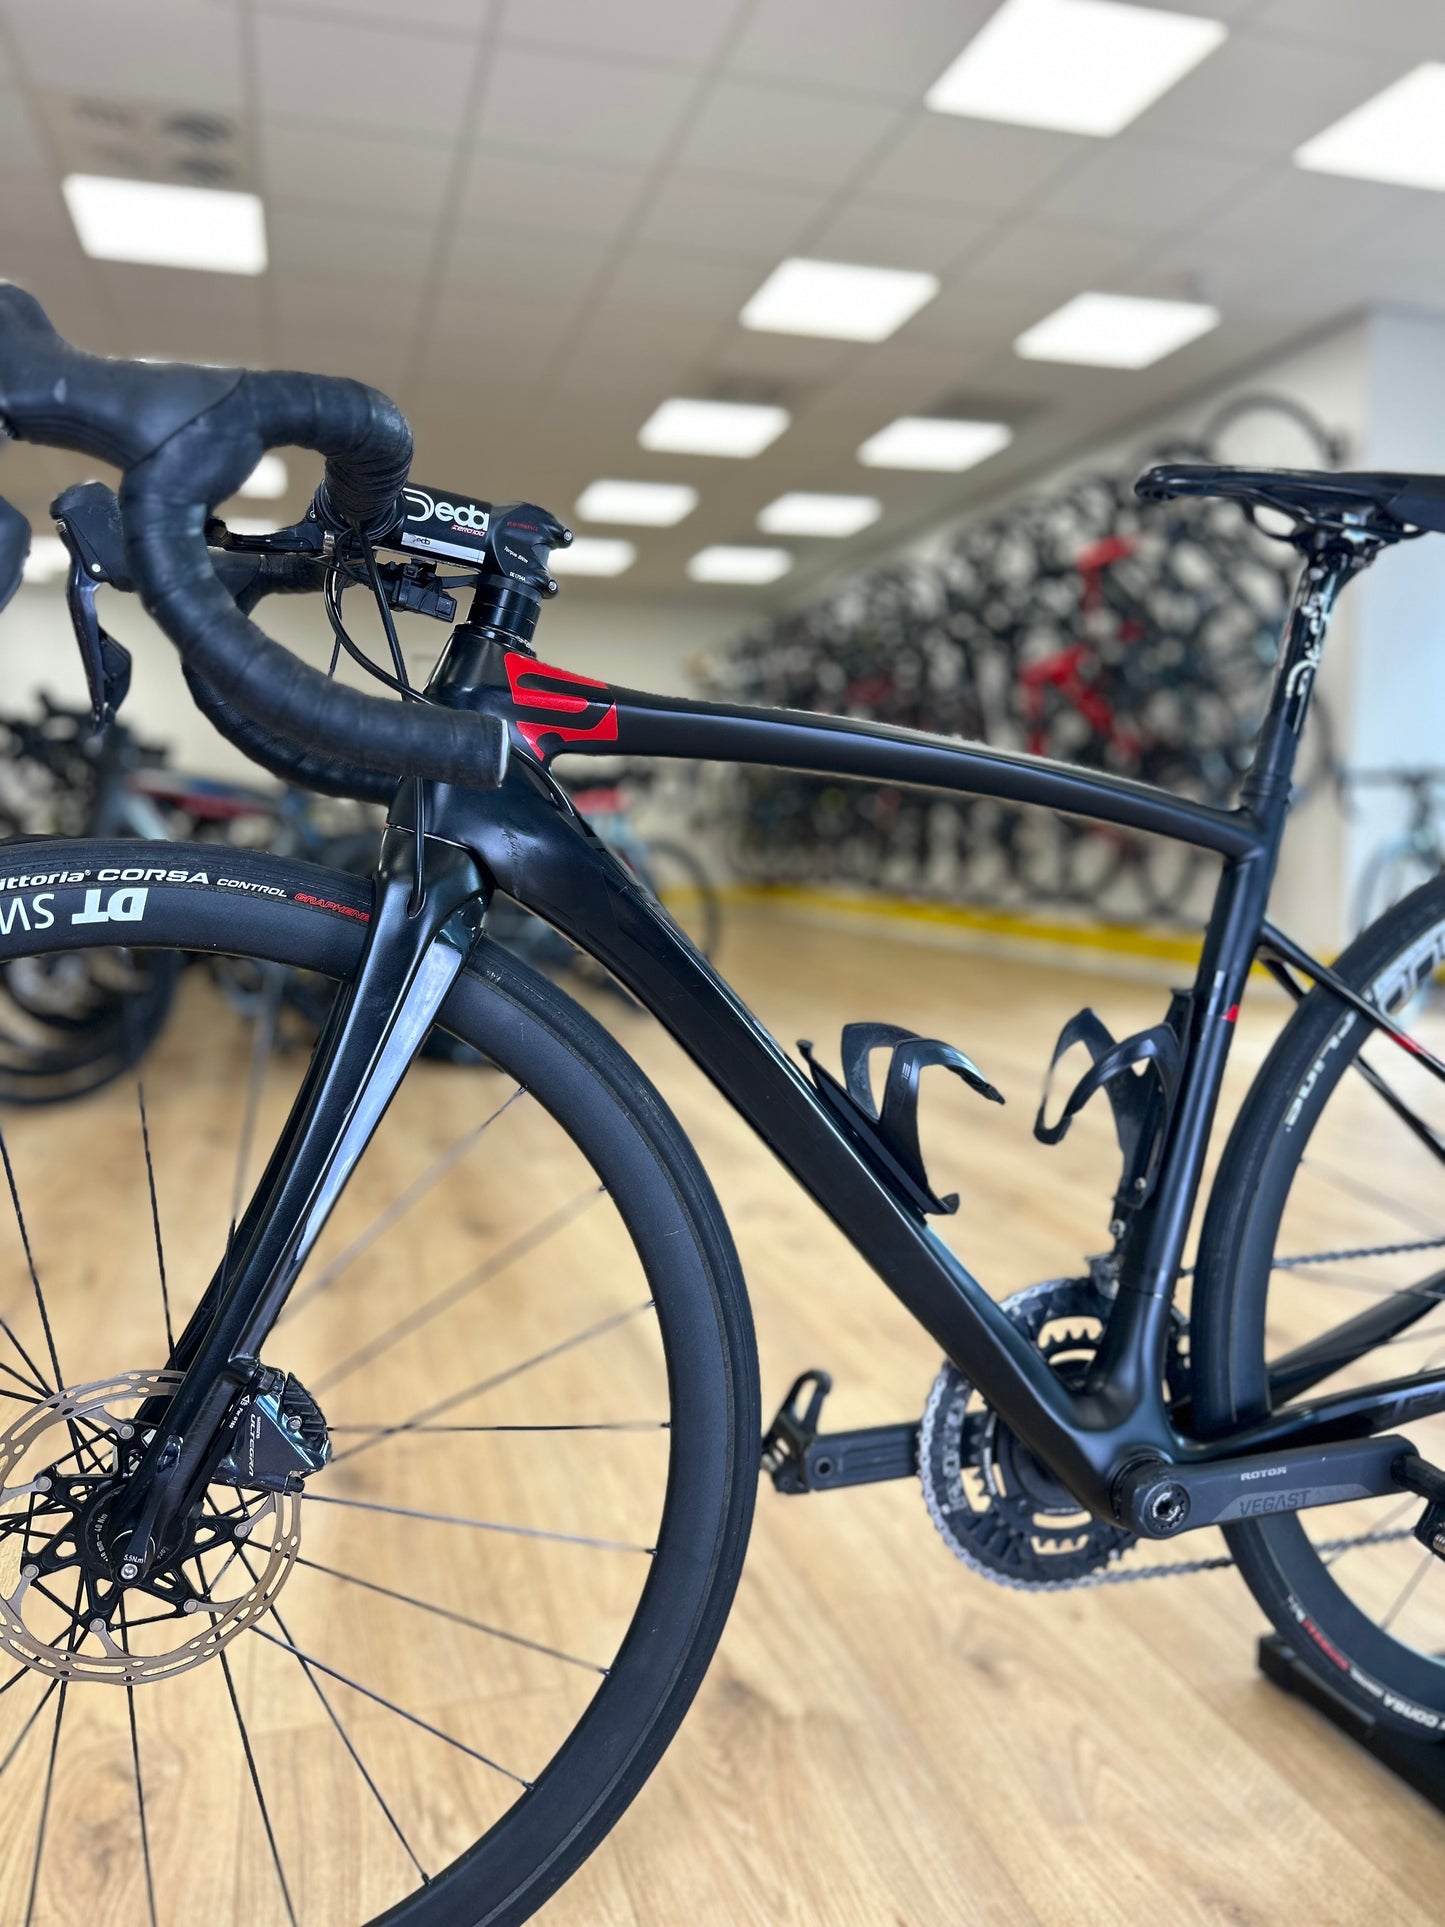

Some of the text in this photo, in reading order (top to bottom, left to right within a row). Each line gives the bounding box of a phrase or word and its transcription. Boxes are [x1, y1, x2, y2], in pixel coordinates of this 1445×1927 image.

[403, 487, 490, 531] Deda
[97, 868, 209, 884] CORSA
[217, 878, 288, 898] CONTROL
[71, 887, 149, 925] DT
[248, 1413, 256, 1477] ULTEGRA
[1240, 1466, 1287, 1481] ROTOR
